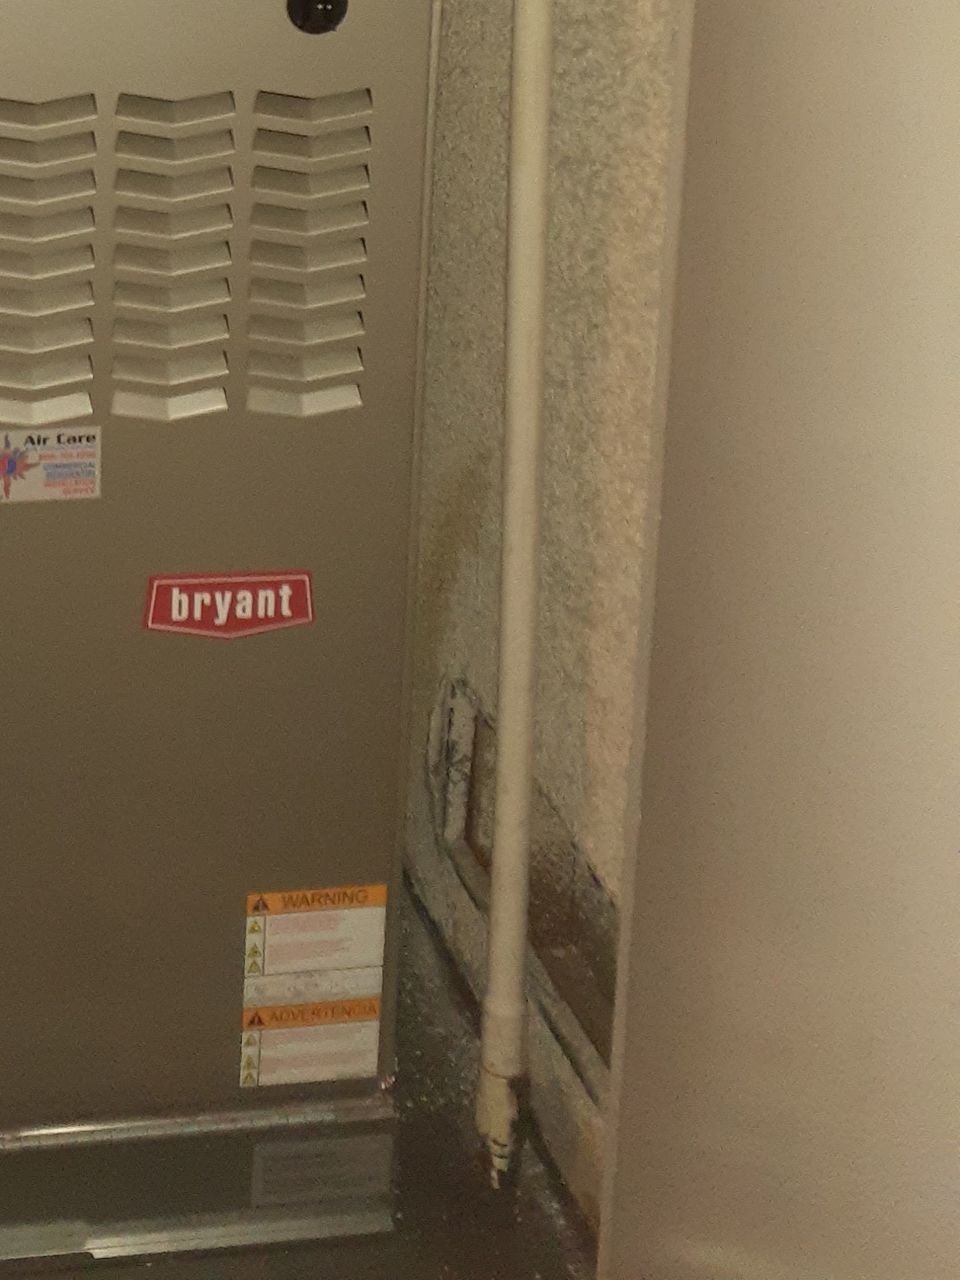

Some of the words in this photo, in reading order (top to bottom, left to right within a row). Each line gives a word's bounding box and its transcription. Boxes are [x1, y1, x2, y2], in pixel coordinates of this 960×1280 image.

[24, 434, 49, 446] Air
[56, 433, 96, 445] Care
[171, 584, 292, 625] bryant
[281, 889, 369, 908] WARNING
[270, 1004, 378, 1022] ADVERTENCIA
